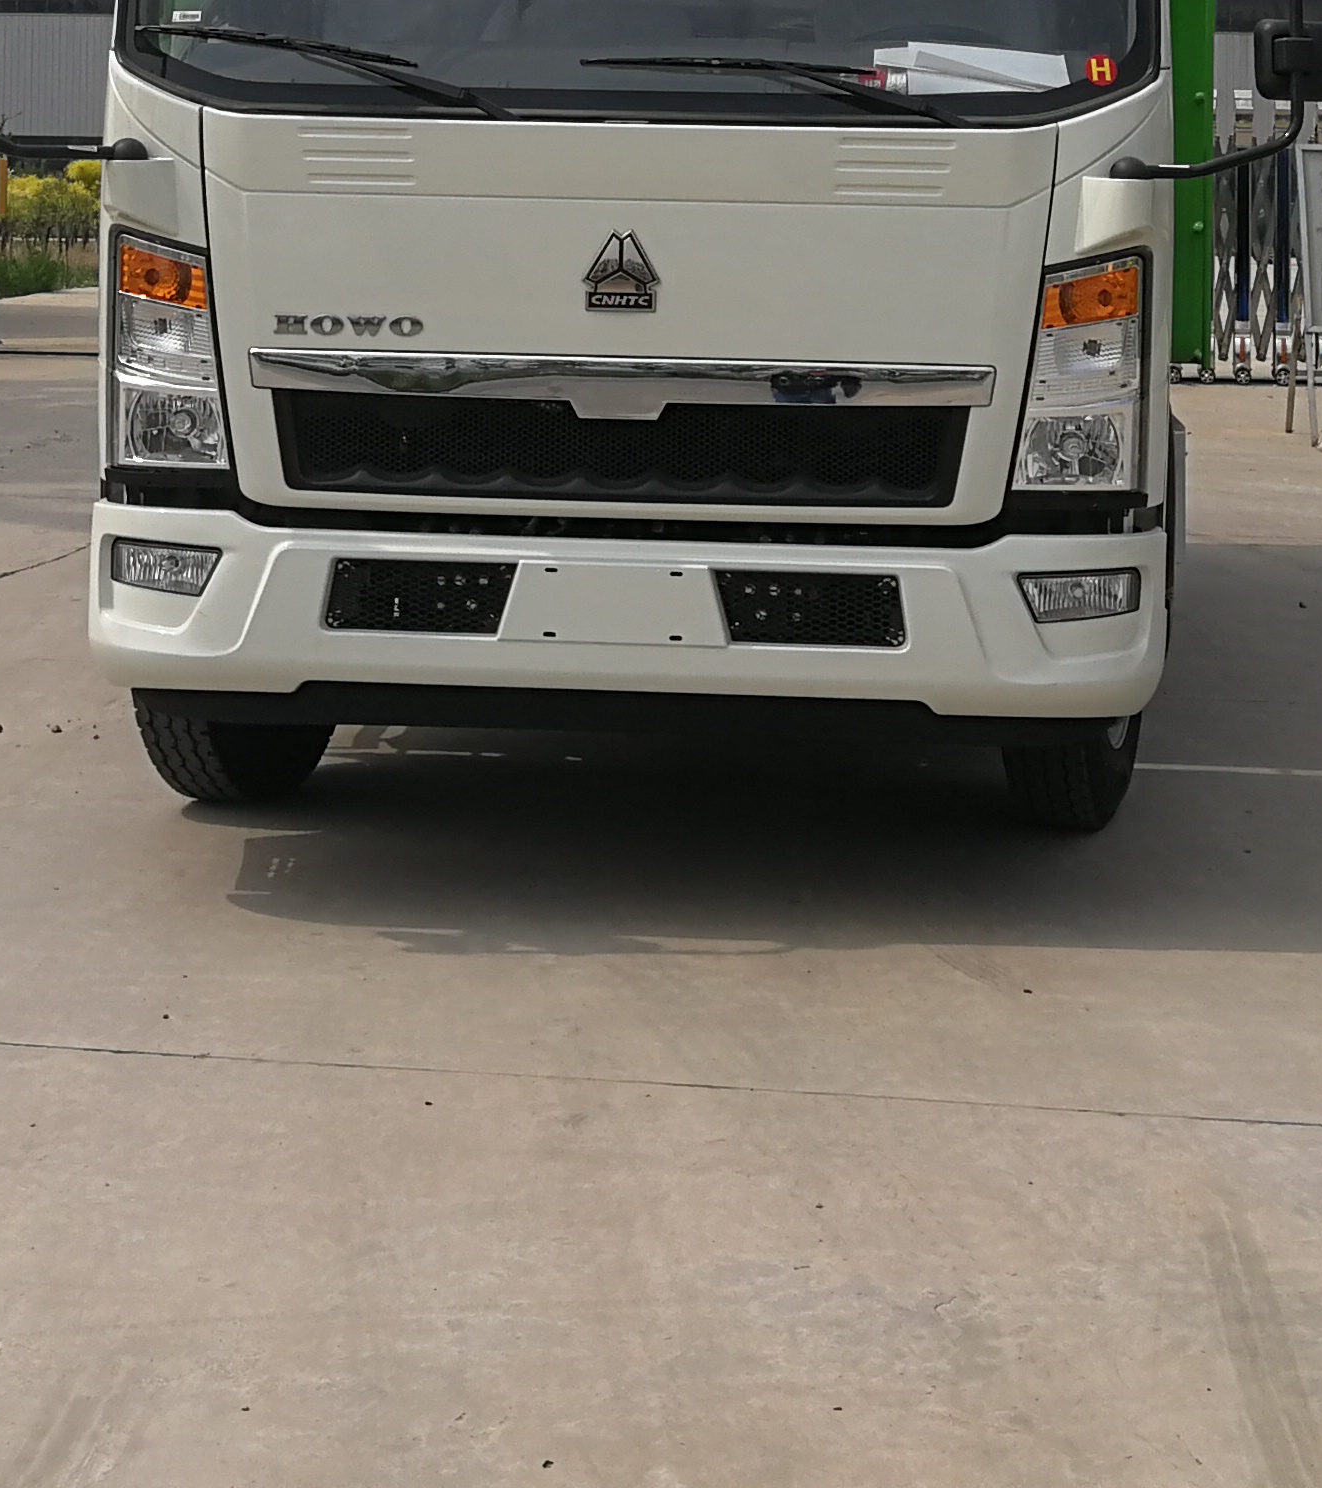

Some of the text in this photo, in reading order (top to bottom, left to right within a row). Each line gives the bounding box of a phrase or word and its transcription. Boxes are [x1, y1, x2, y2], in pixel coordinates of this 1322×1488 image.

[1090, 58, 1111, 81] H
[591, 294, 650, 306] CNHTC
[274, 314, 423, 337] HOWO
